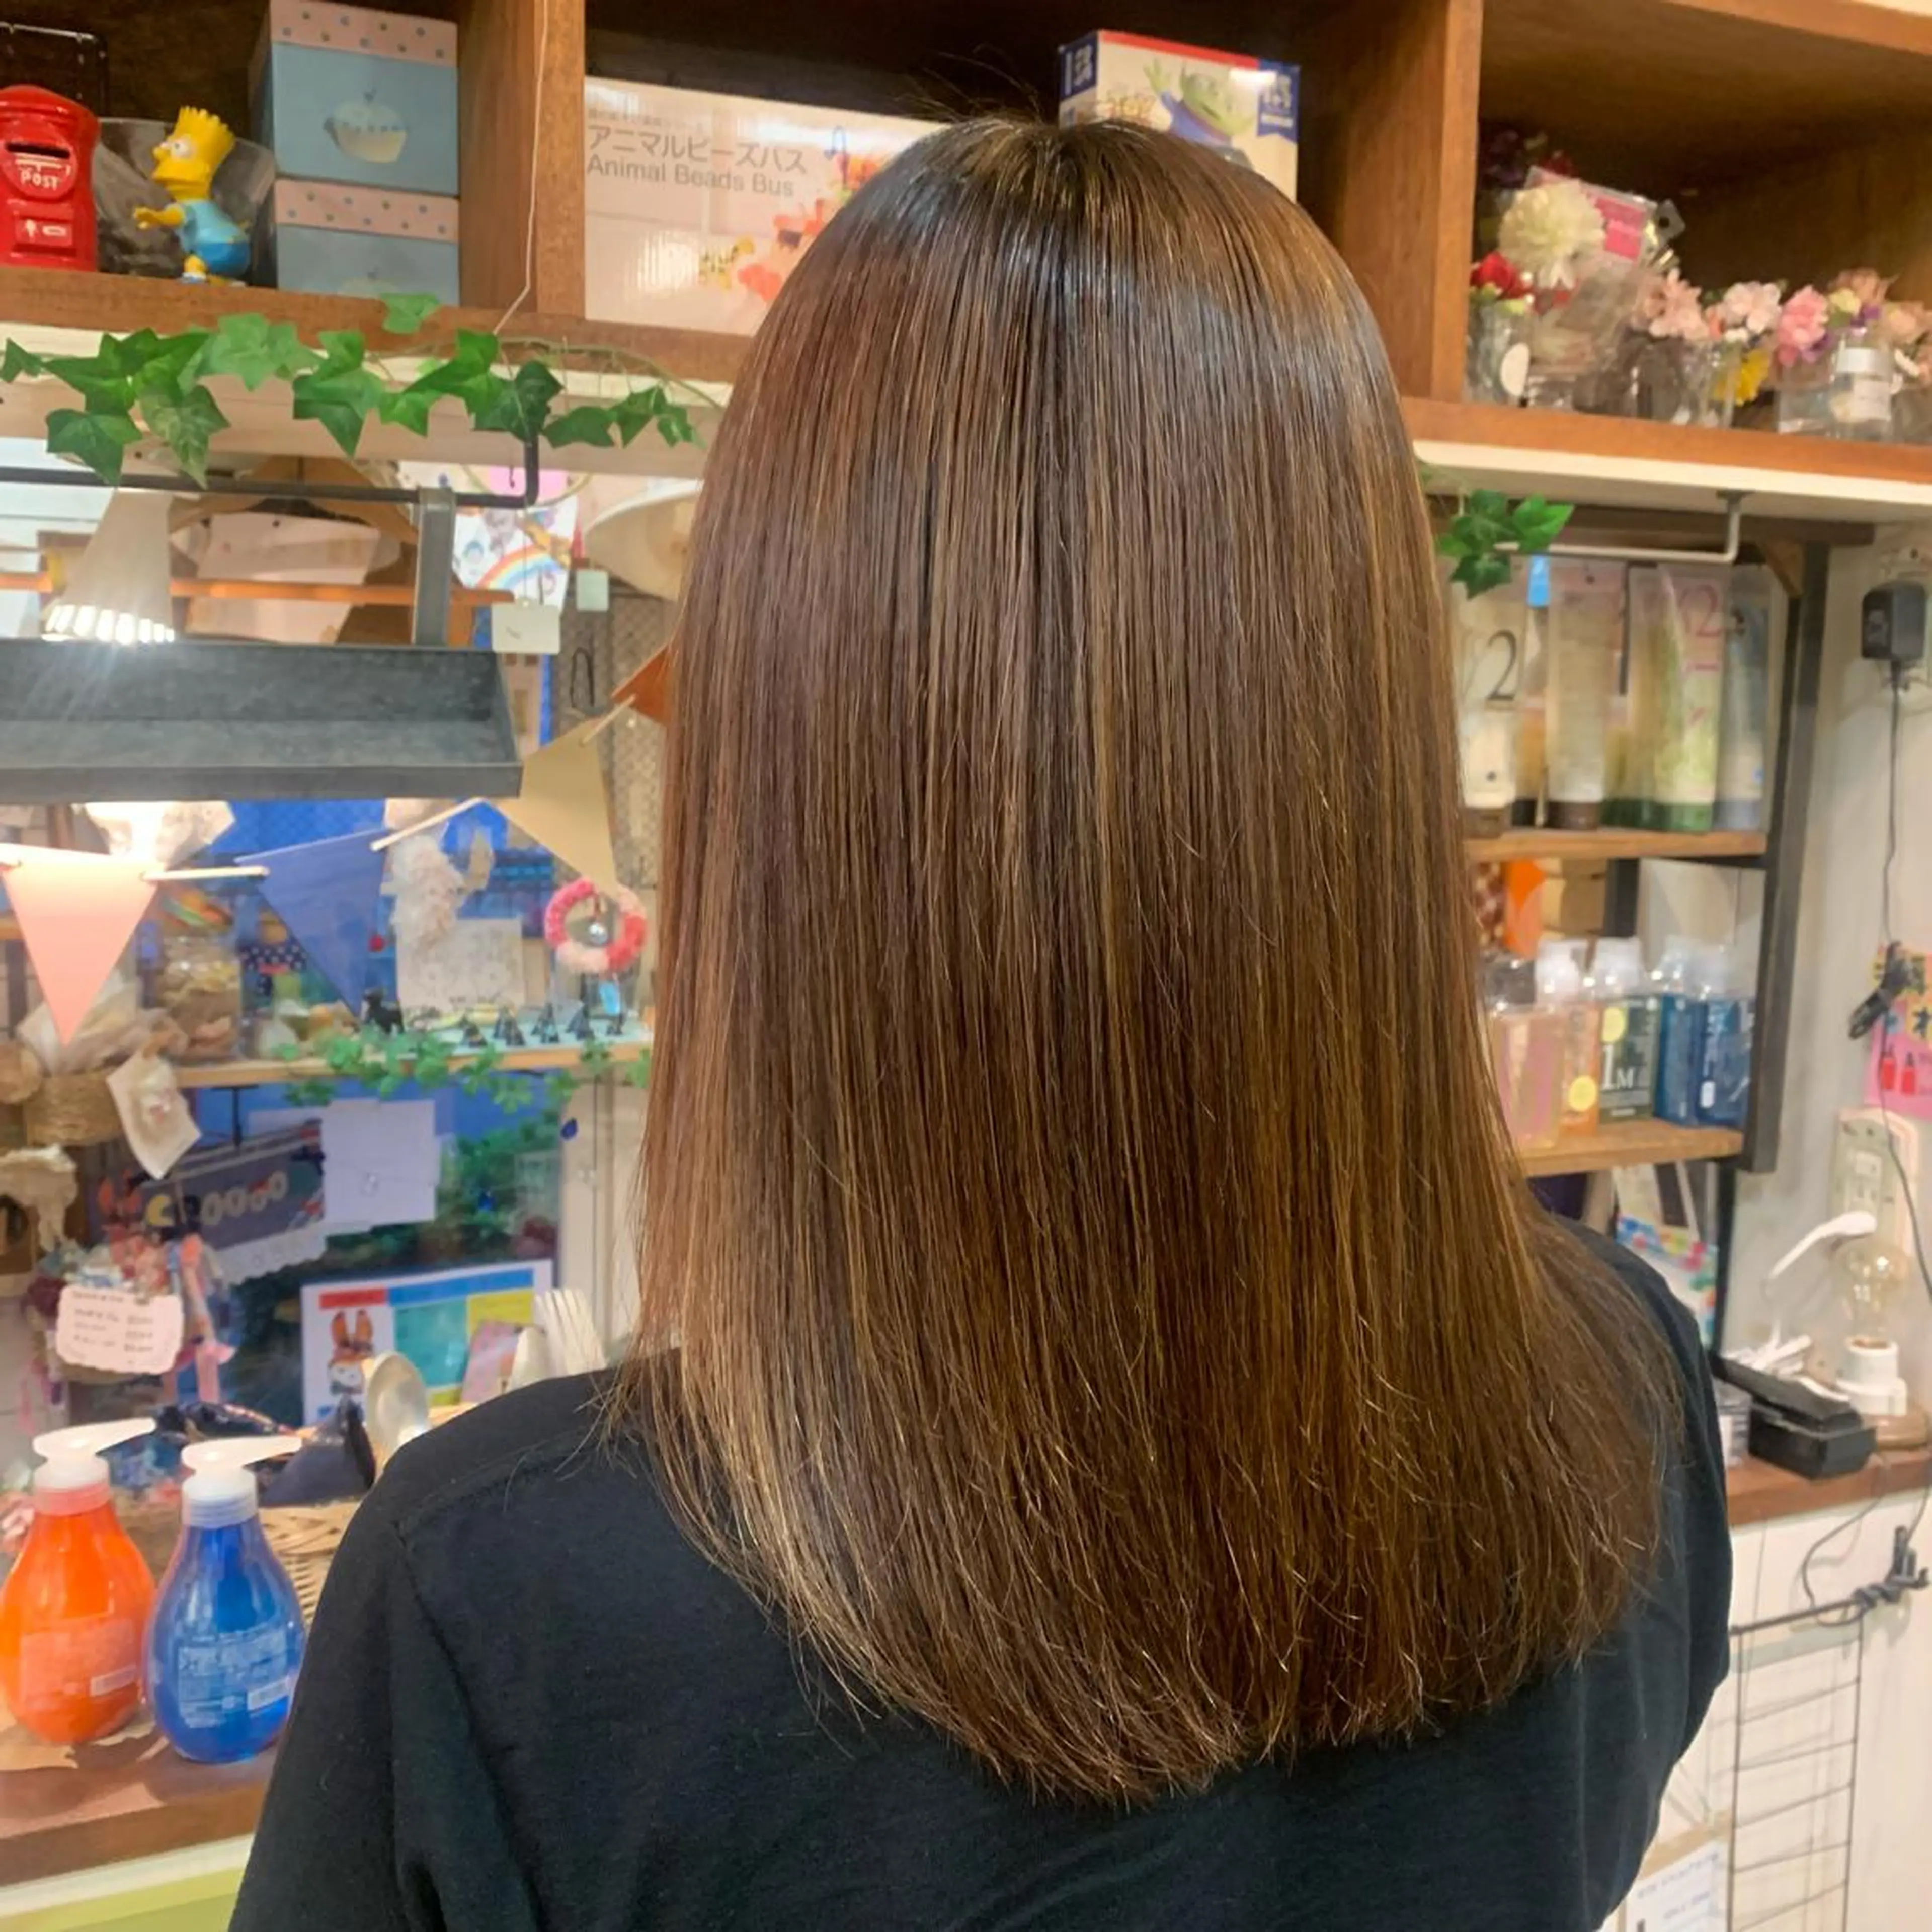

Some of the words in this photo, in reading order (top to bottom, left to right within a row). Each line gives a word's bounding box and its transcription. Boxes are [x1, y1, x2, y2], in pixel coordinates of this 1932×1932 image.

[587, 153, 666, 182] Animal
[674, 163, 745, 191] Beads
[751, 172, 794, 197] Bus
[1487, 629, 1517, 701] 2
